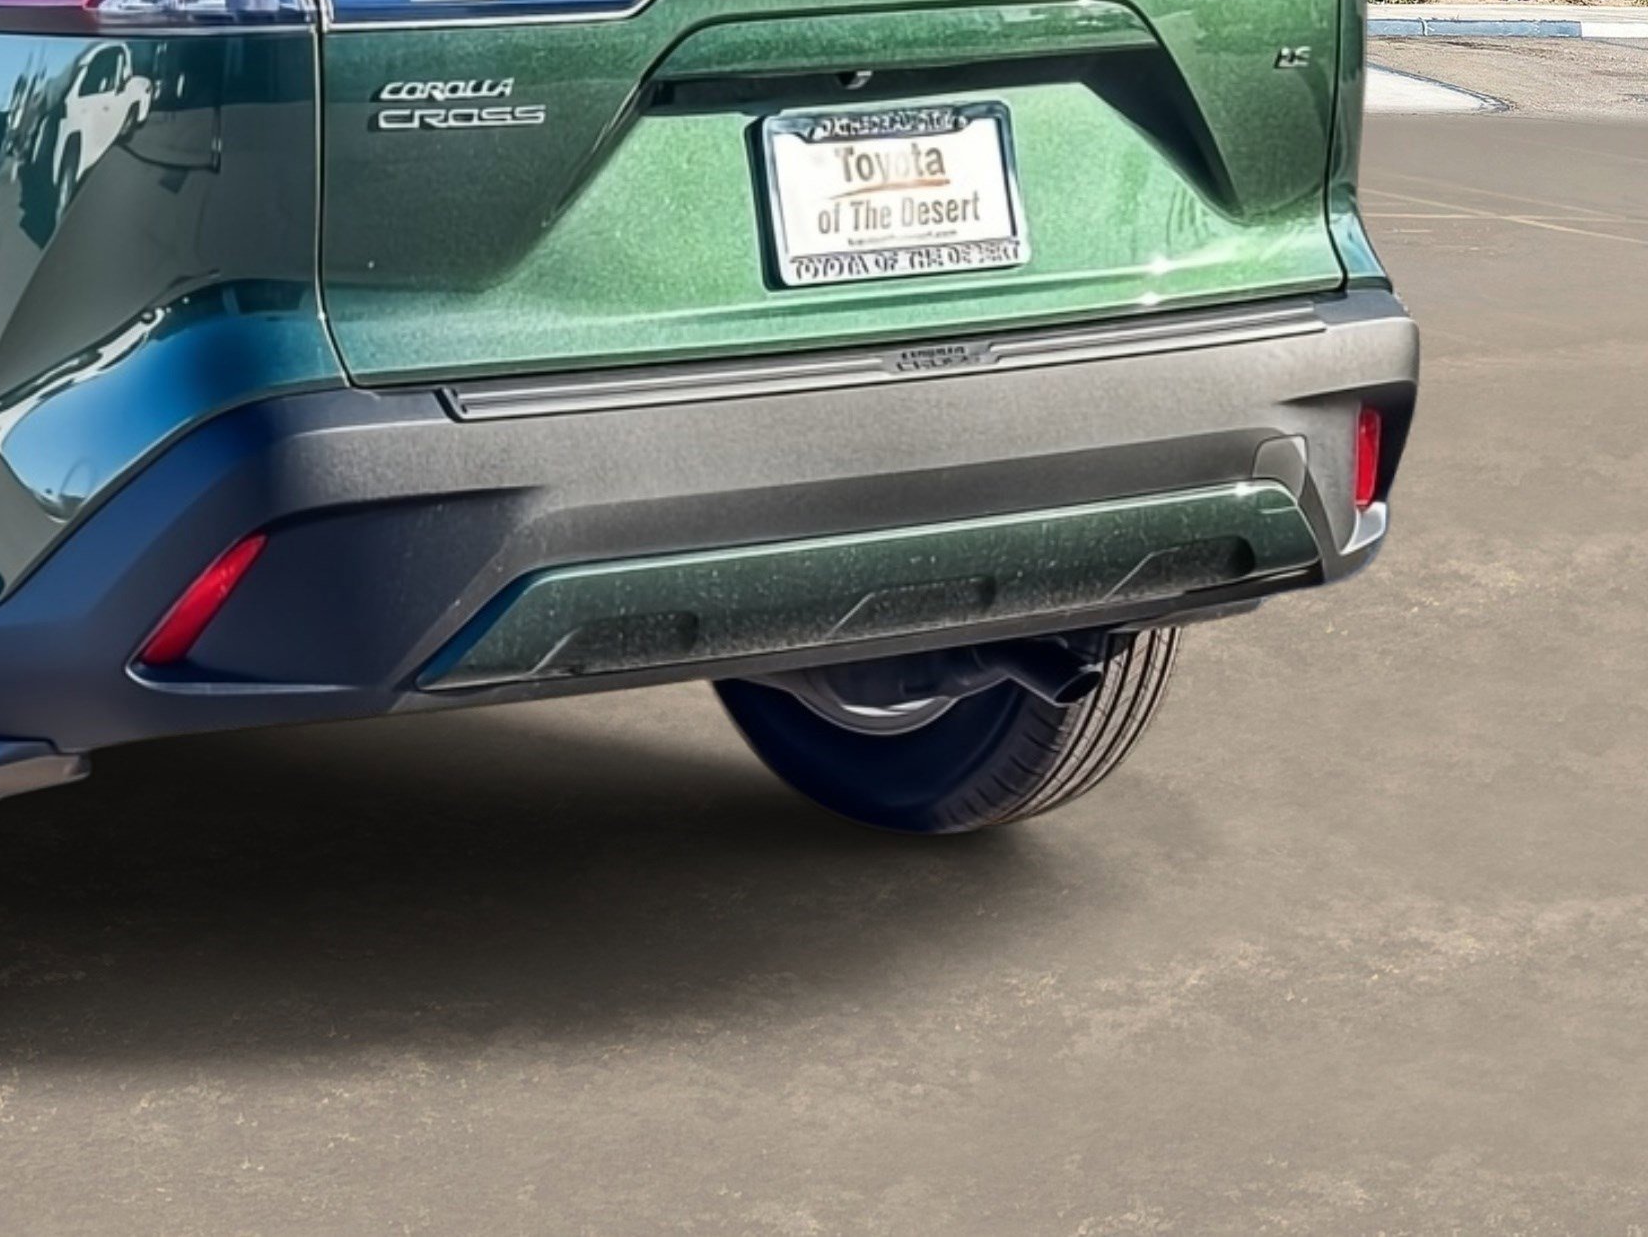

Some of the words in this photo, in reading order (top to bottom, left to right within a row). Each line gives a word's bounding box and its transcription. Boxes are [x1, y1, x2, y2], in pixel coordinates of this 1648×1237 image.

[379, 77, 515, 102] COROLLA
[378, 104, 546, 129] CROSS
[835, 142, 947, 184] Toyota
[818, 202, 841, 235] of
[850, 197, 892, 232] The
[901, 190, 981, 227] Desert
